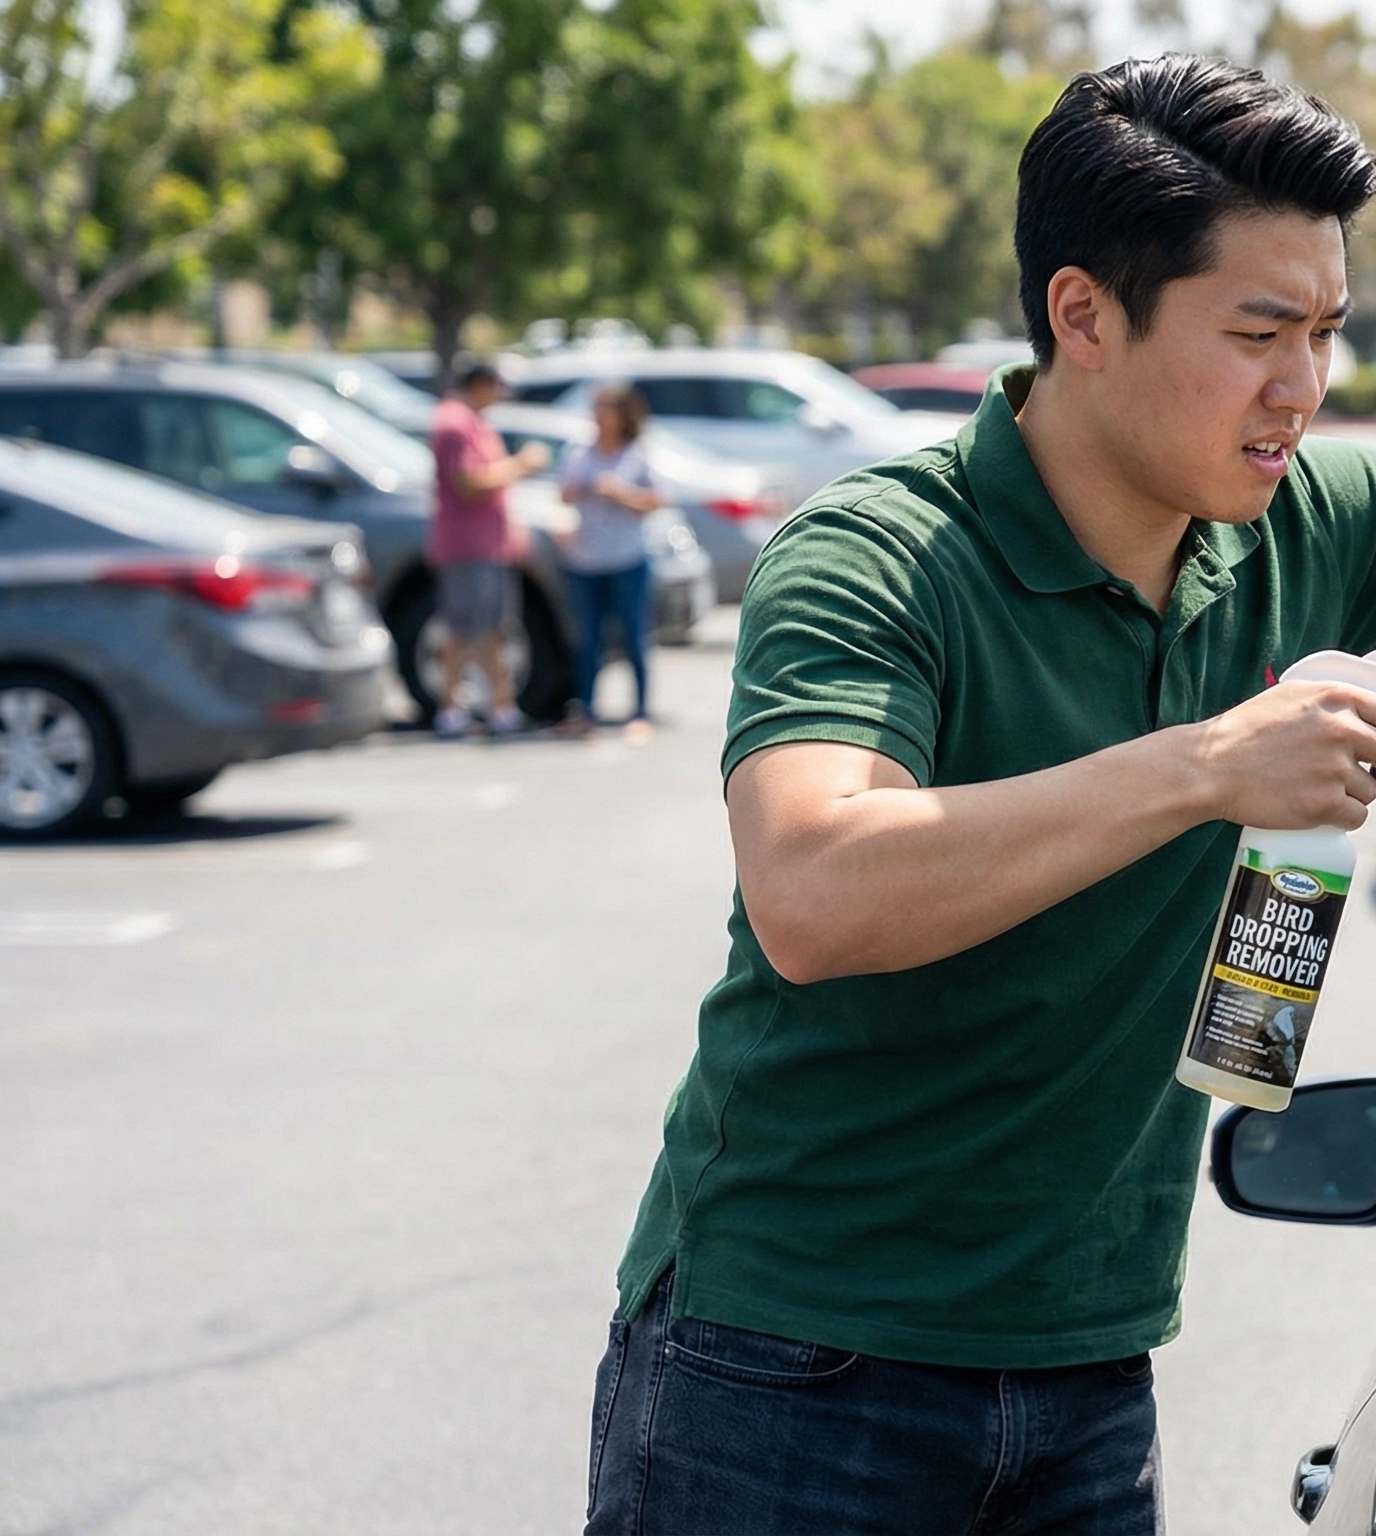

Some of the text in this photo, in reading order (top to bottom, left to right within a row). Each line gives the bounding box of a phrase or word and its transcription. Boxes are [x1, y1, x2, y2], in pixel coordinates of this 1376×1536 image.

[1229, 914, 1329, 962] DROPPING
[1262, 898, 1314, 932] BIRD
[1226, 940, 1319, 986] REMOVER
